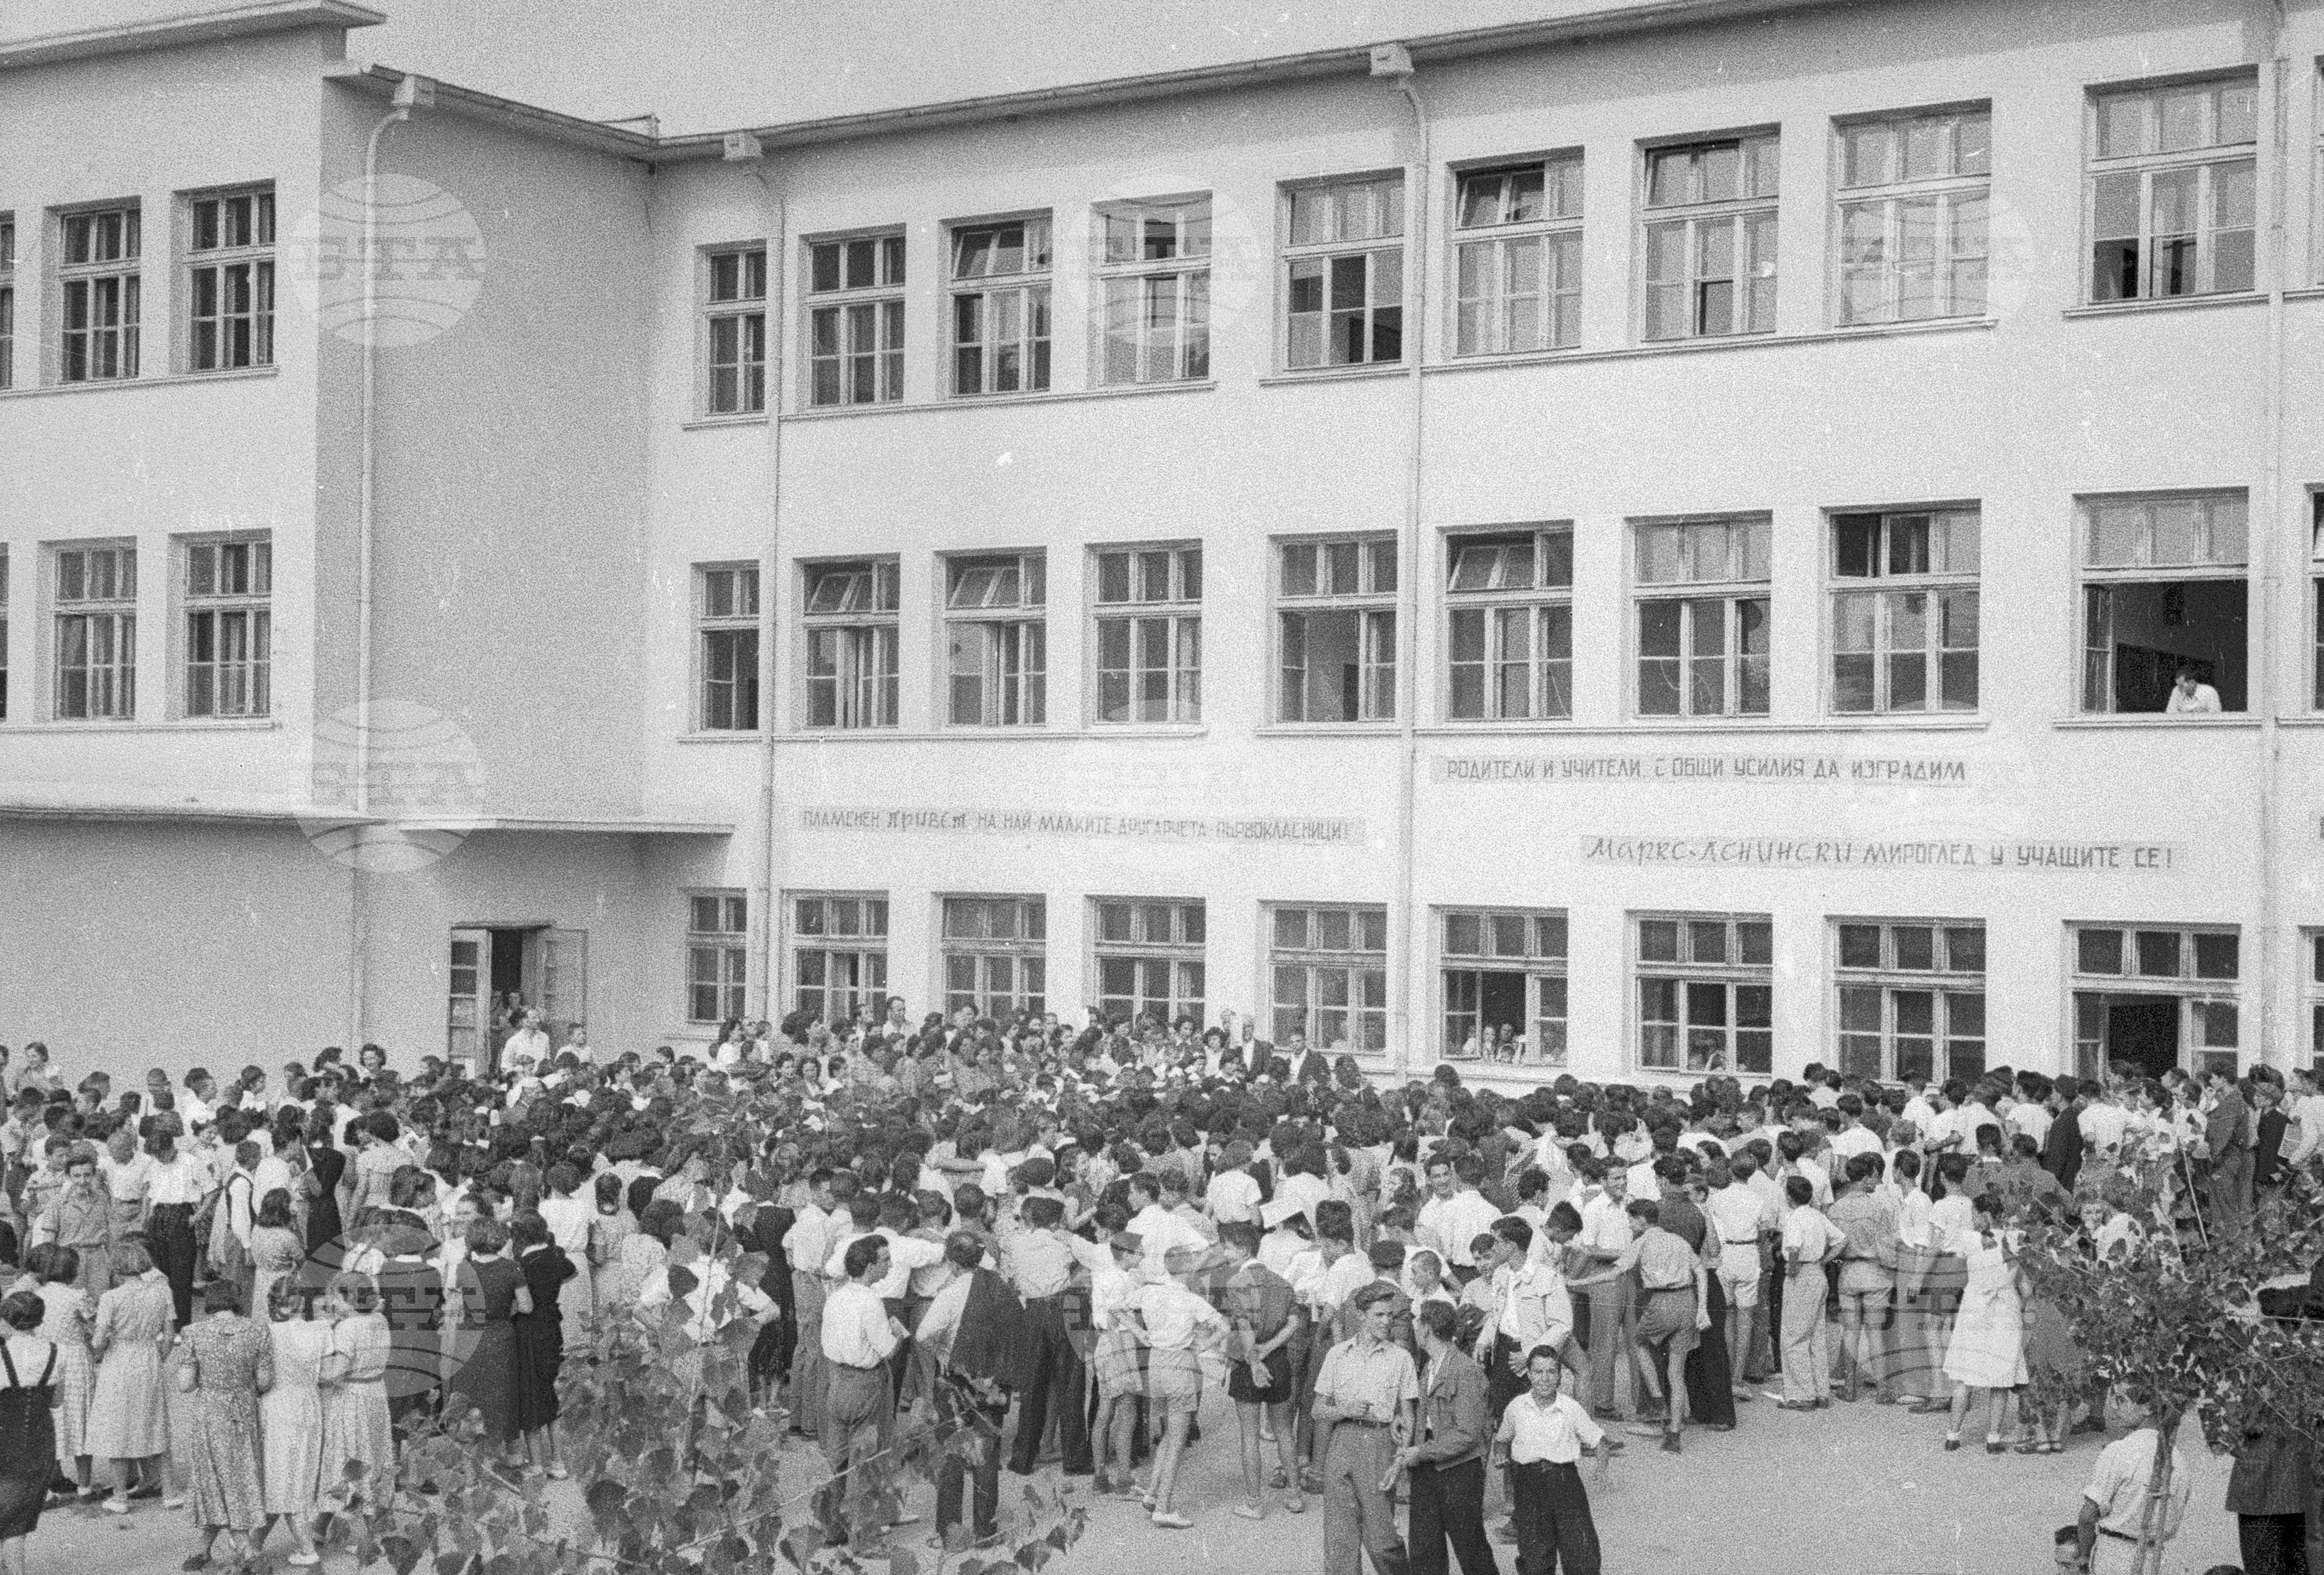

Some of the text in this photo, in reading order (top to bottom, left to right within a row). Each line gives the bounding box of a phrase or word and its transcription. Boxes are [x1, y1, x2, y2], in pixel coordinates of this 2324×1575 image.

[1448, 760, 1534, 779] РОДИТЕЛИ
[1544, 760, 1554, 778] И
[1672, 757, 1723, 778] ОБЩИ
[1734, 758, 1805, 778] УСИЛИЯ
[1813, 758, 1840, 779] ДА
[1852, 760, 1966, 781] ИЗГРАДИМ
[803, 810, 880, 828] ПЛАМЕНЕН
[977, 812, 997, 829] НА
[1863, 843, 1977, 865] МИРОГЛЕД
[1991, 844, 2004, 865] У
[2017, 845, 2119, 868] УЧАЩИТЕ
